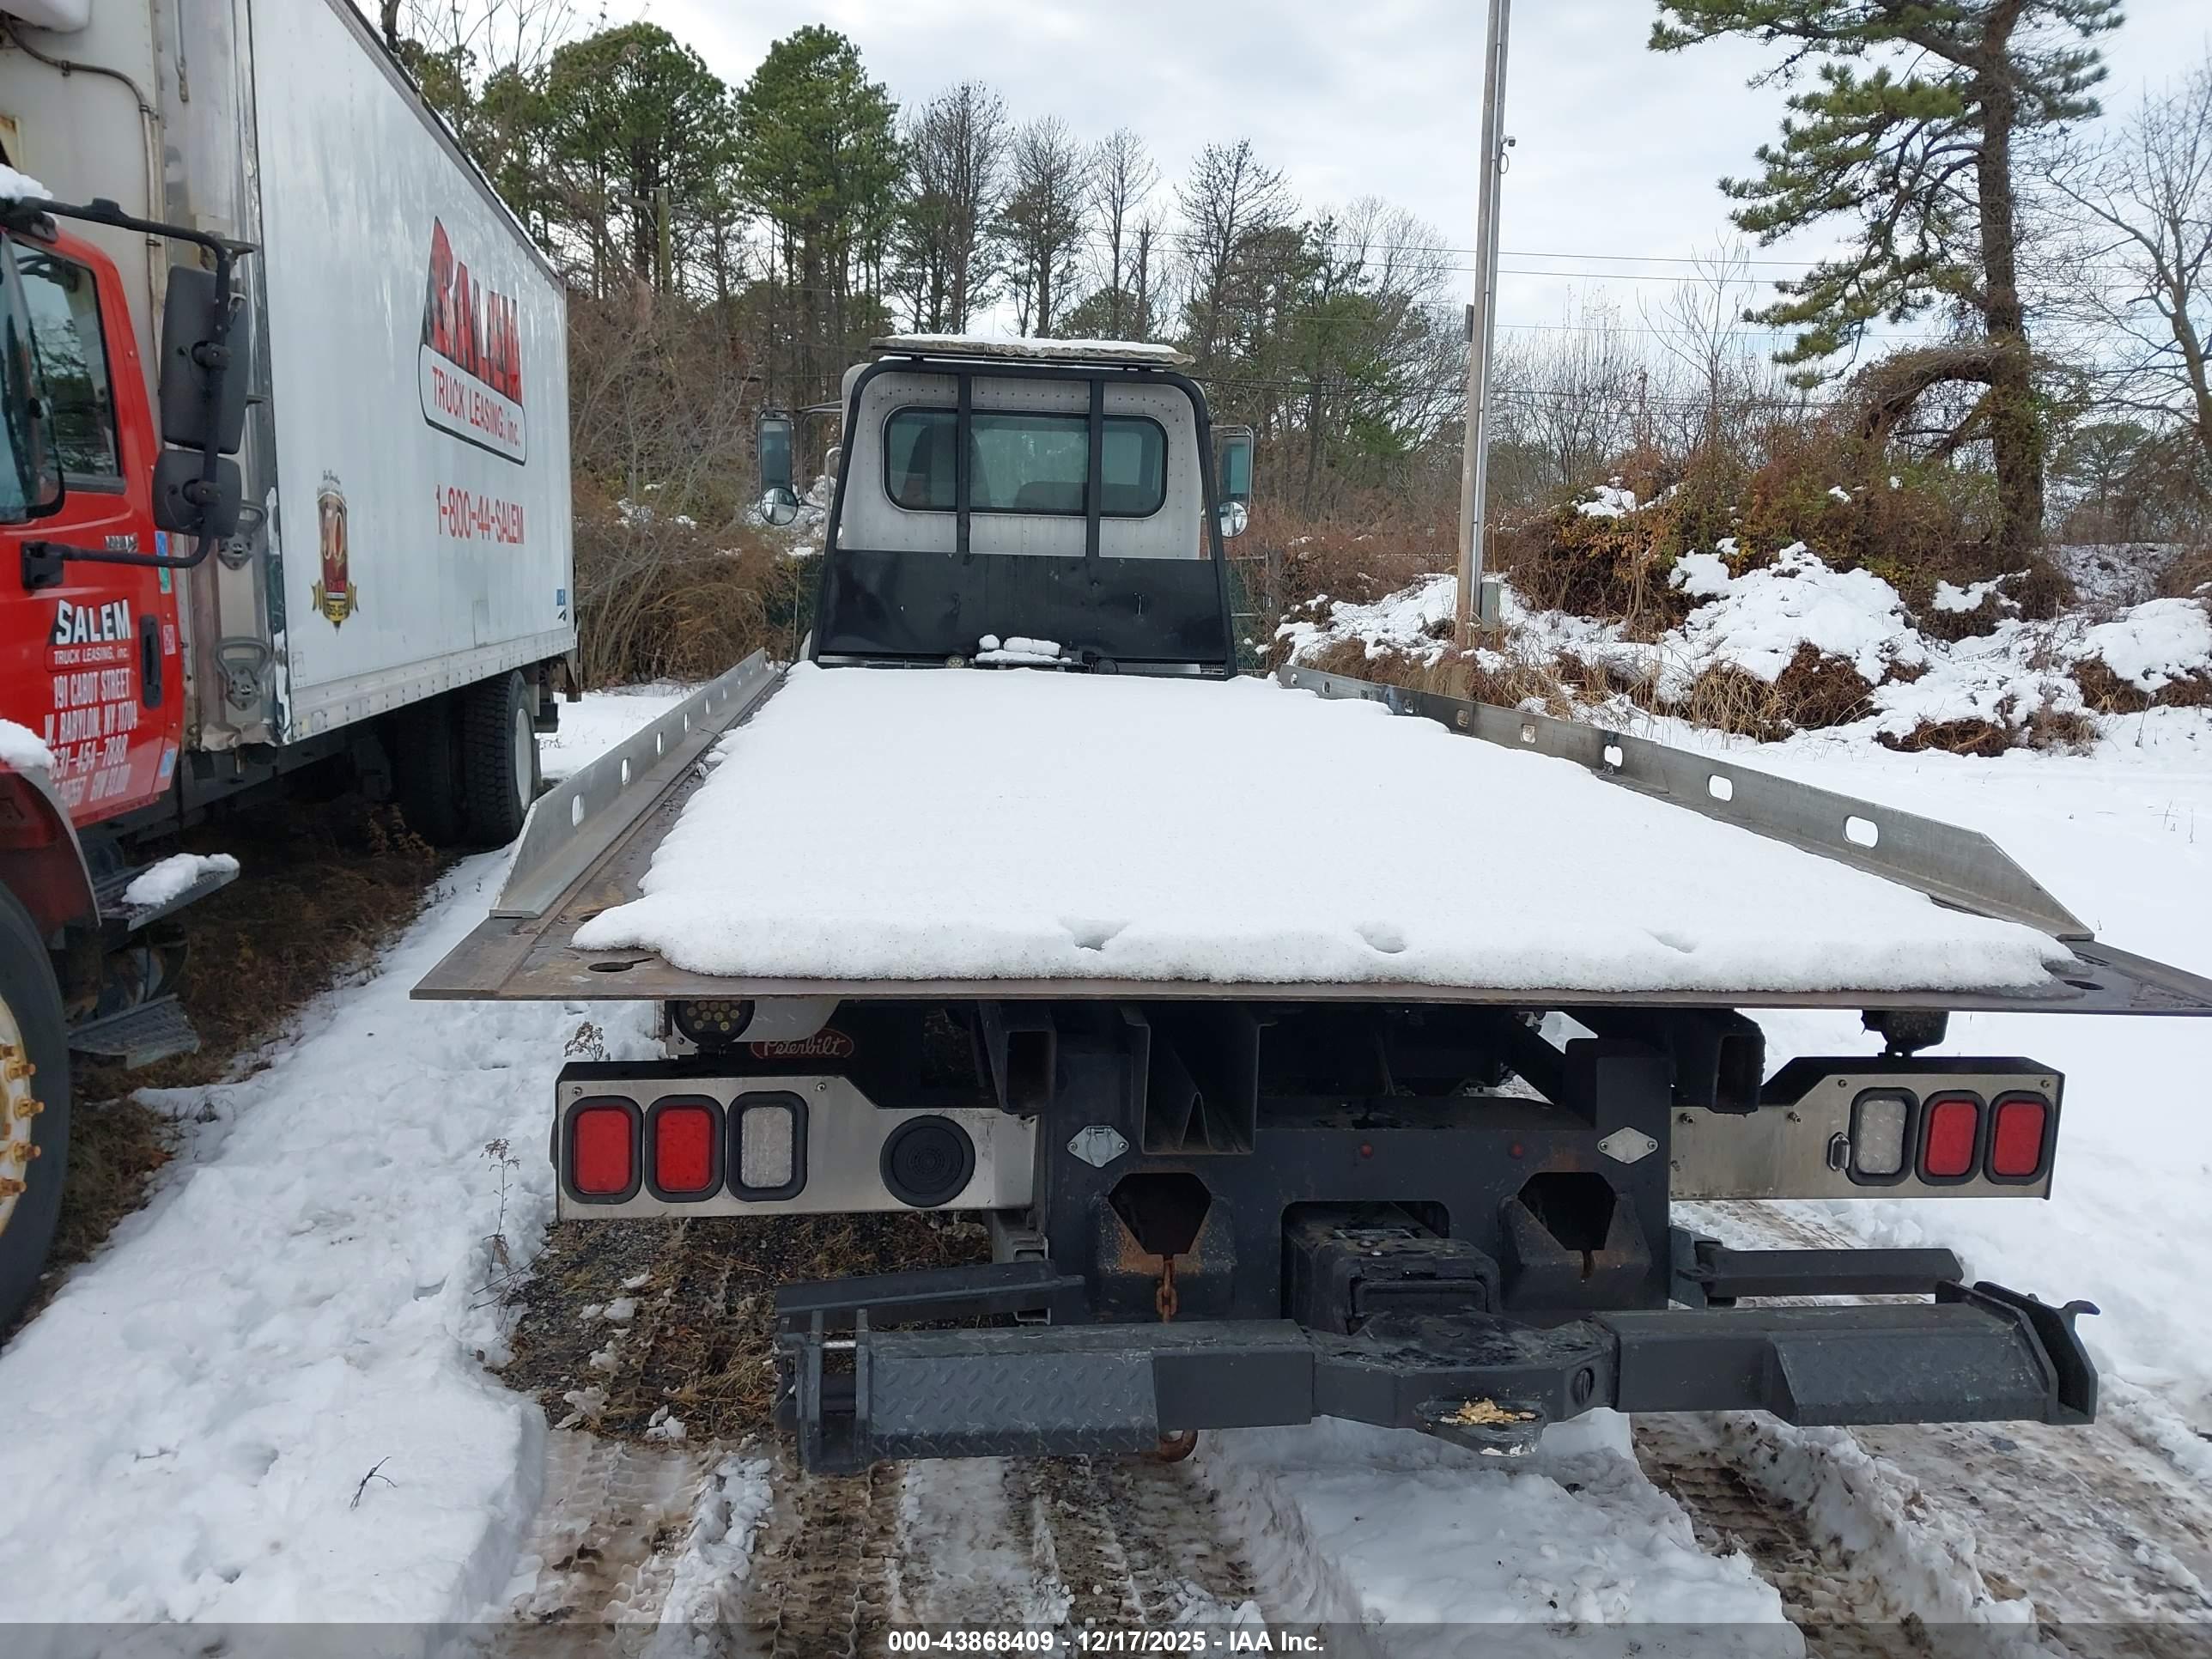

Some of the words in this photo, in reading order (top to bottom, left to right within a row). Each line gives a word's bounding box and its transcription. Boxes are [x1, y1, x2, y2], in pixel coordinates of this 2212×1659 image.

[432, 366, 466, 420] TRUCK
[435, 483, 525, 545] 1-800-44-SALEM
[55, 599, 131, 645] SALEM
[53, 647, 81, 665] TRUCK
[53, 674, 69, 710] 191
[70, 671, 99, 707] CABOT
[100, 667, 131, 702] STREET
[763, 1036, 846, 1057] Peterbilt
